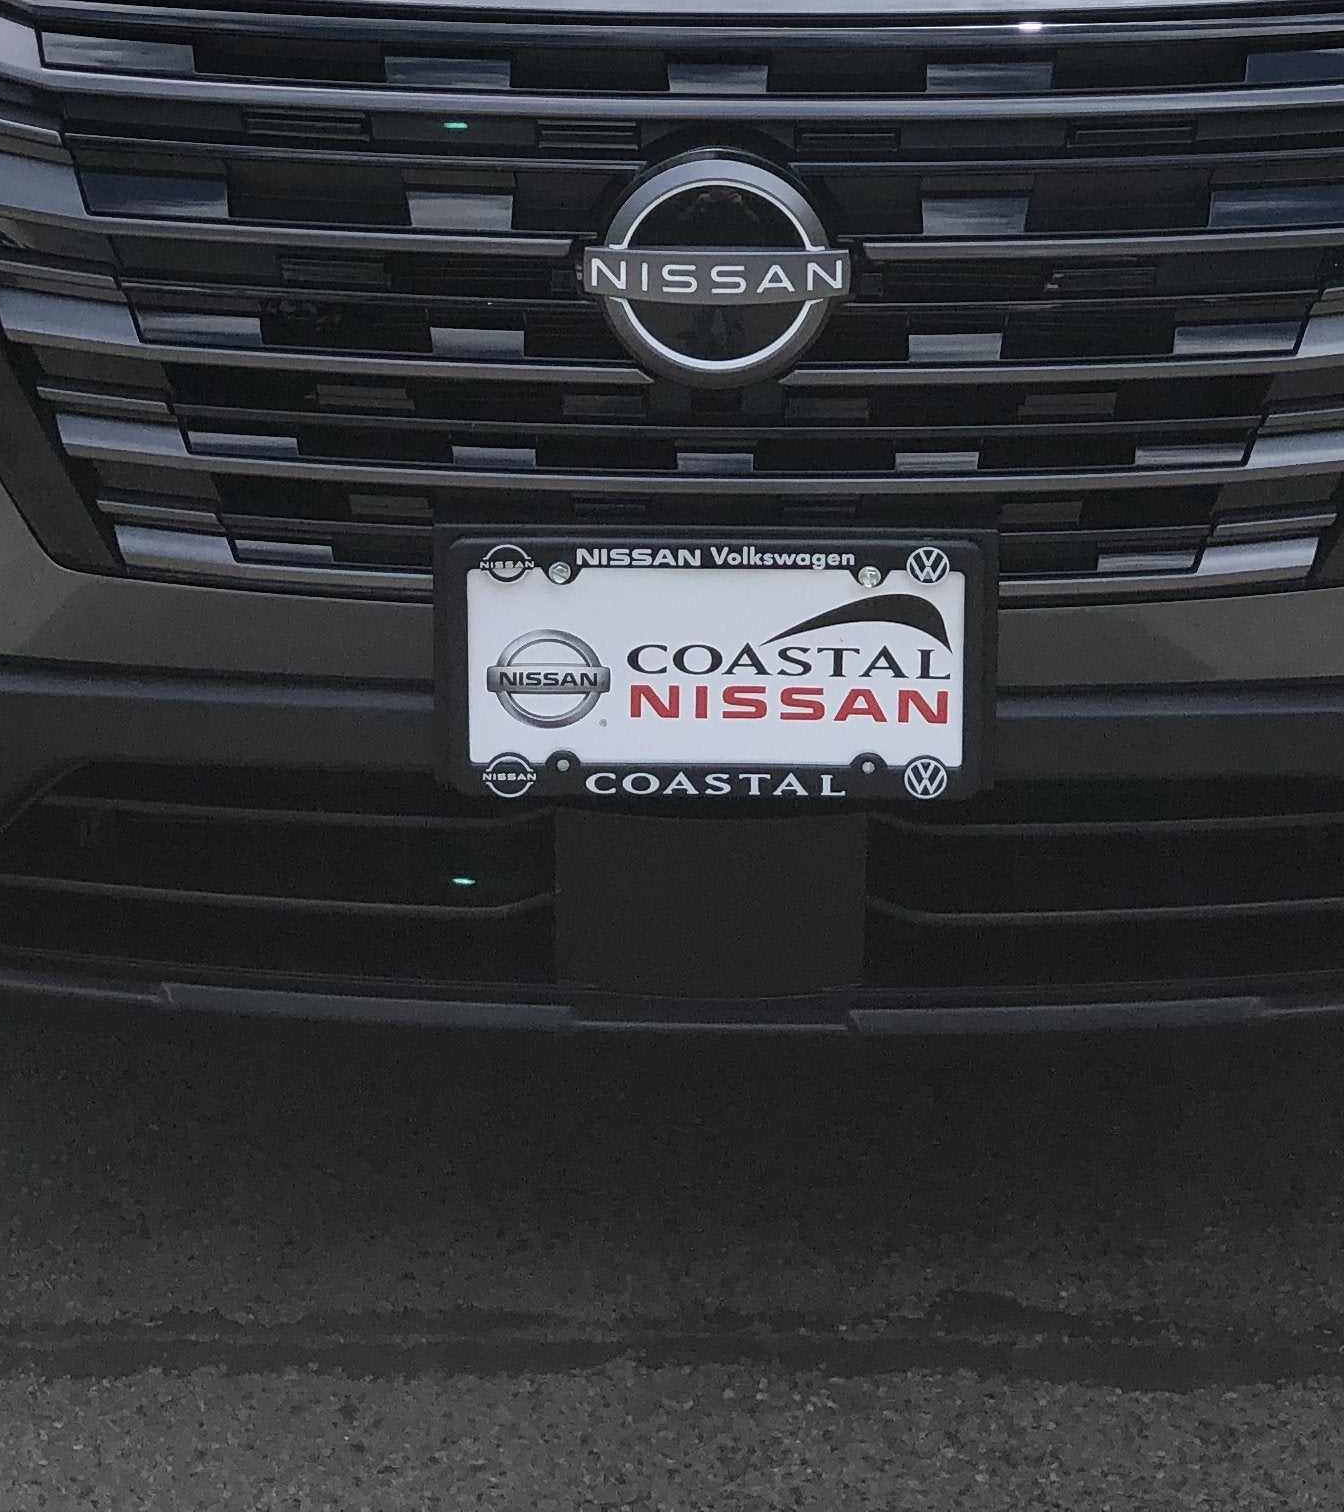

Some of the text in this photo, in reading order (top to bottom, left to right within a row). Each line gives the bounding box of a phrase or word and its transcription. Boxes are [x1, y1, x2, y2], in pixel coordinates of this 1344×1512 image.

[590, 257, 844, 295] NISSAN
[479, 560, 535, 570] NISSAN
[576, 546, 855, 570] NISSAN Volkswagen
[626, 642, 951, 680] COASTAL
[499, 671, 598, 687] NISSAN
[630, 684, 949, 725] NISSAN
[482, 772, 537, 781] NISSAN
[585, 771, 846, 796] COASTAL
